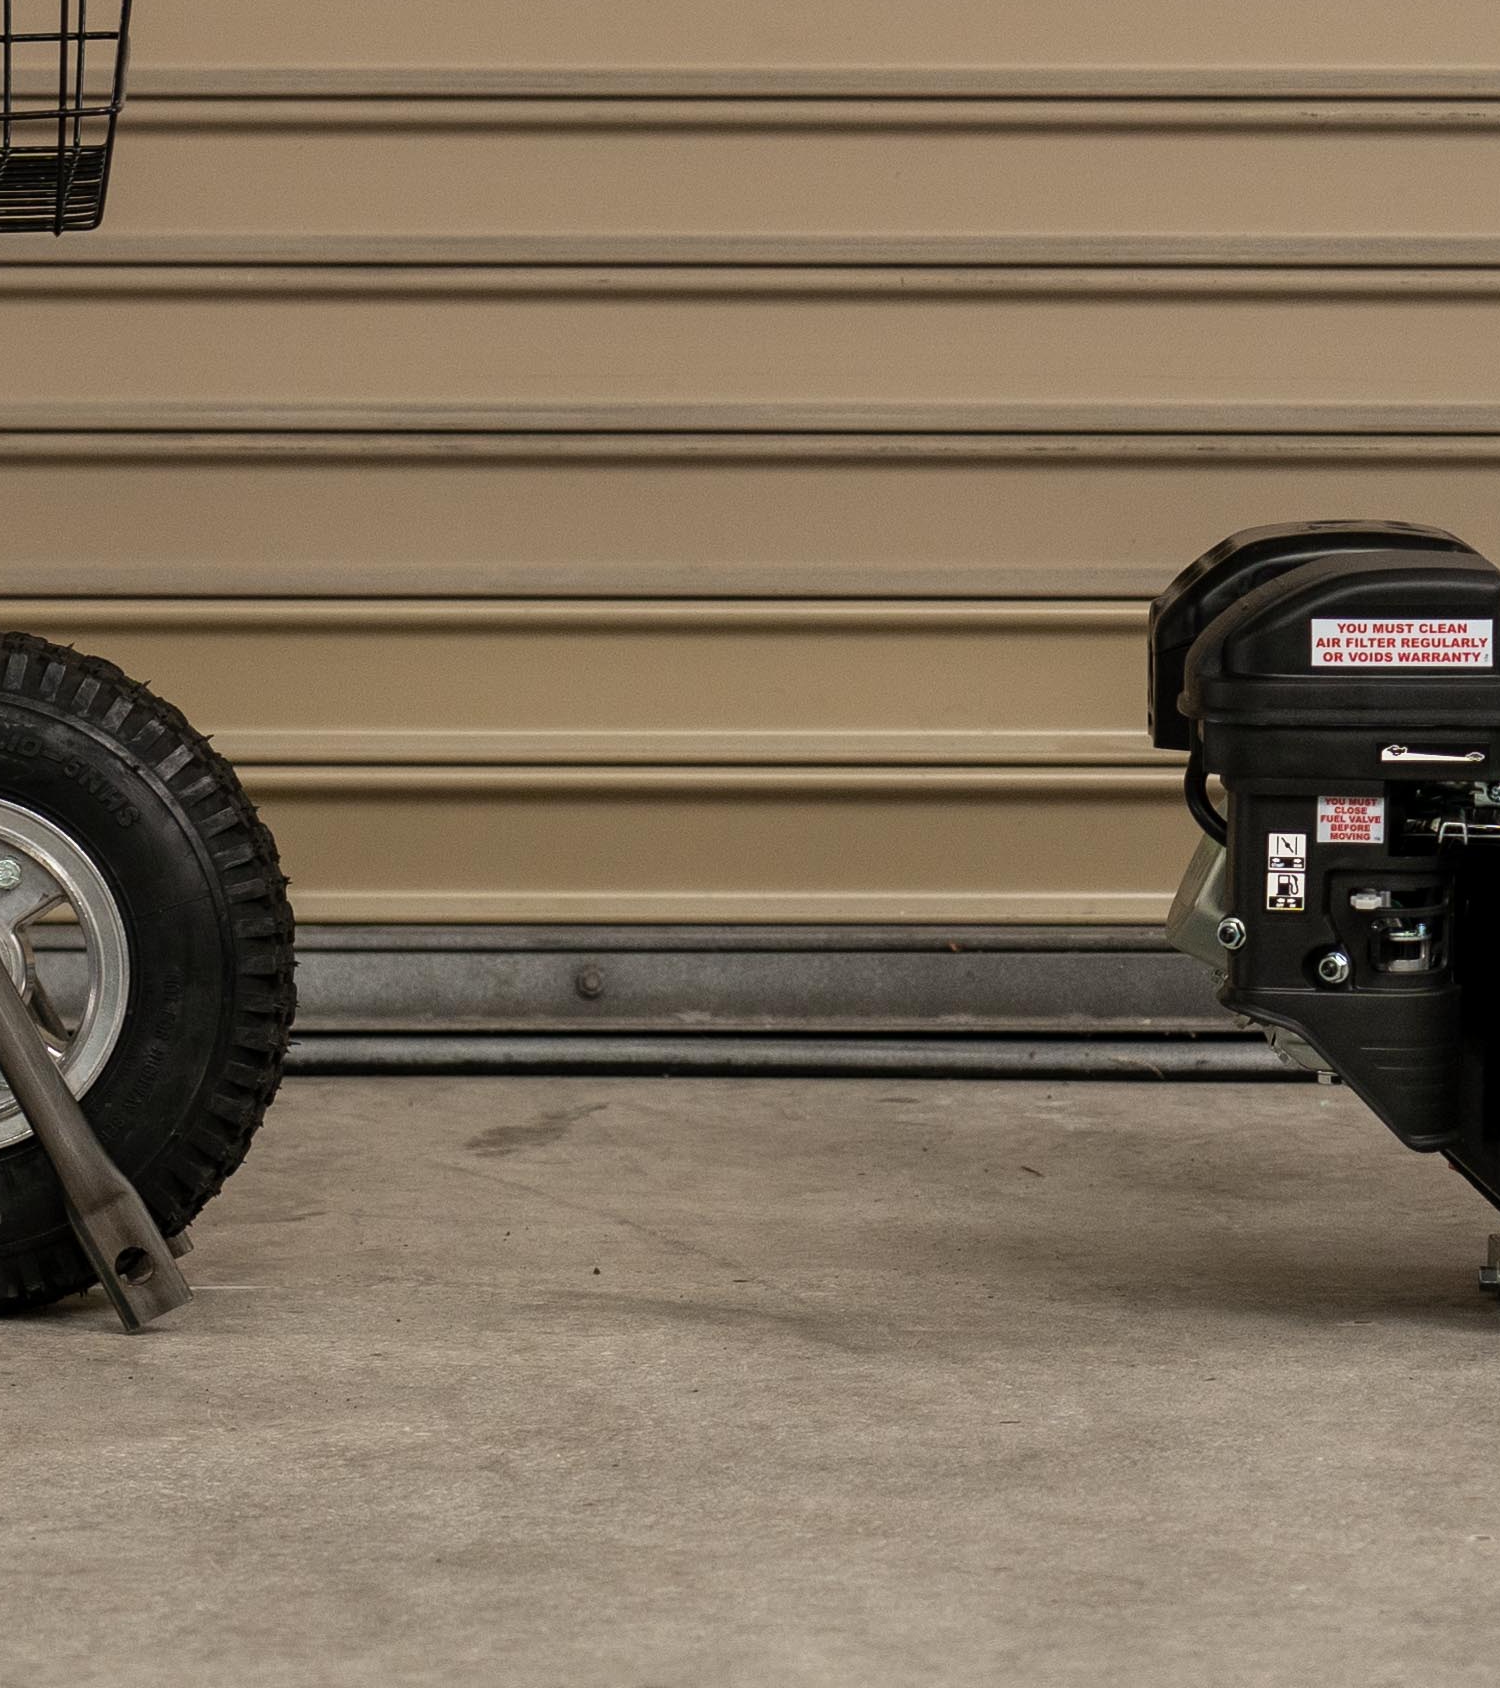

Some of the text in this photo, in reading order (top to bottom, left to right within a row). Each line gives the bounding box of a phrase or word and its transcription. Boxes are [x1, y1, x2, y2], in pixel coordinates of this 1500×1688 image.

[1337, 623, 1468, 634] YOU MUST CLEAN
[1315, 637, 1488, 648] AIR FILTER REGULARLY
[1322, 651, 1344, 663] OR
[1349, 651, 1394, 663] VOIDS
[1397, 651, 1482, 663] WARRANTY
[1324, 797, 1378, 807] YOU MUST
[1334, 806, 1368, 815] CLOSE
[1320, 814, 1382, 824] FUEL VALVE
[1330, 823, 1371, 832] BEFORE
[1330, 832, 1371, 841] MOVING
